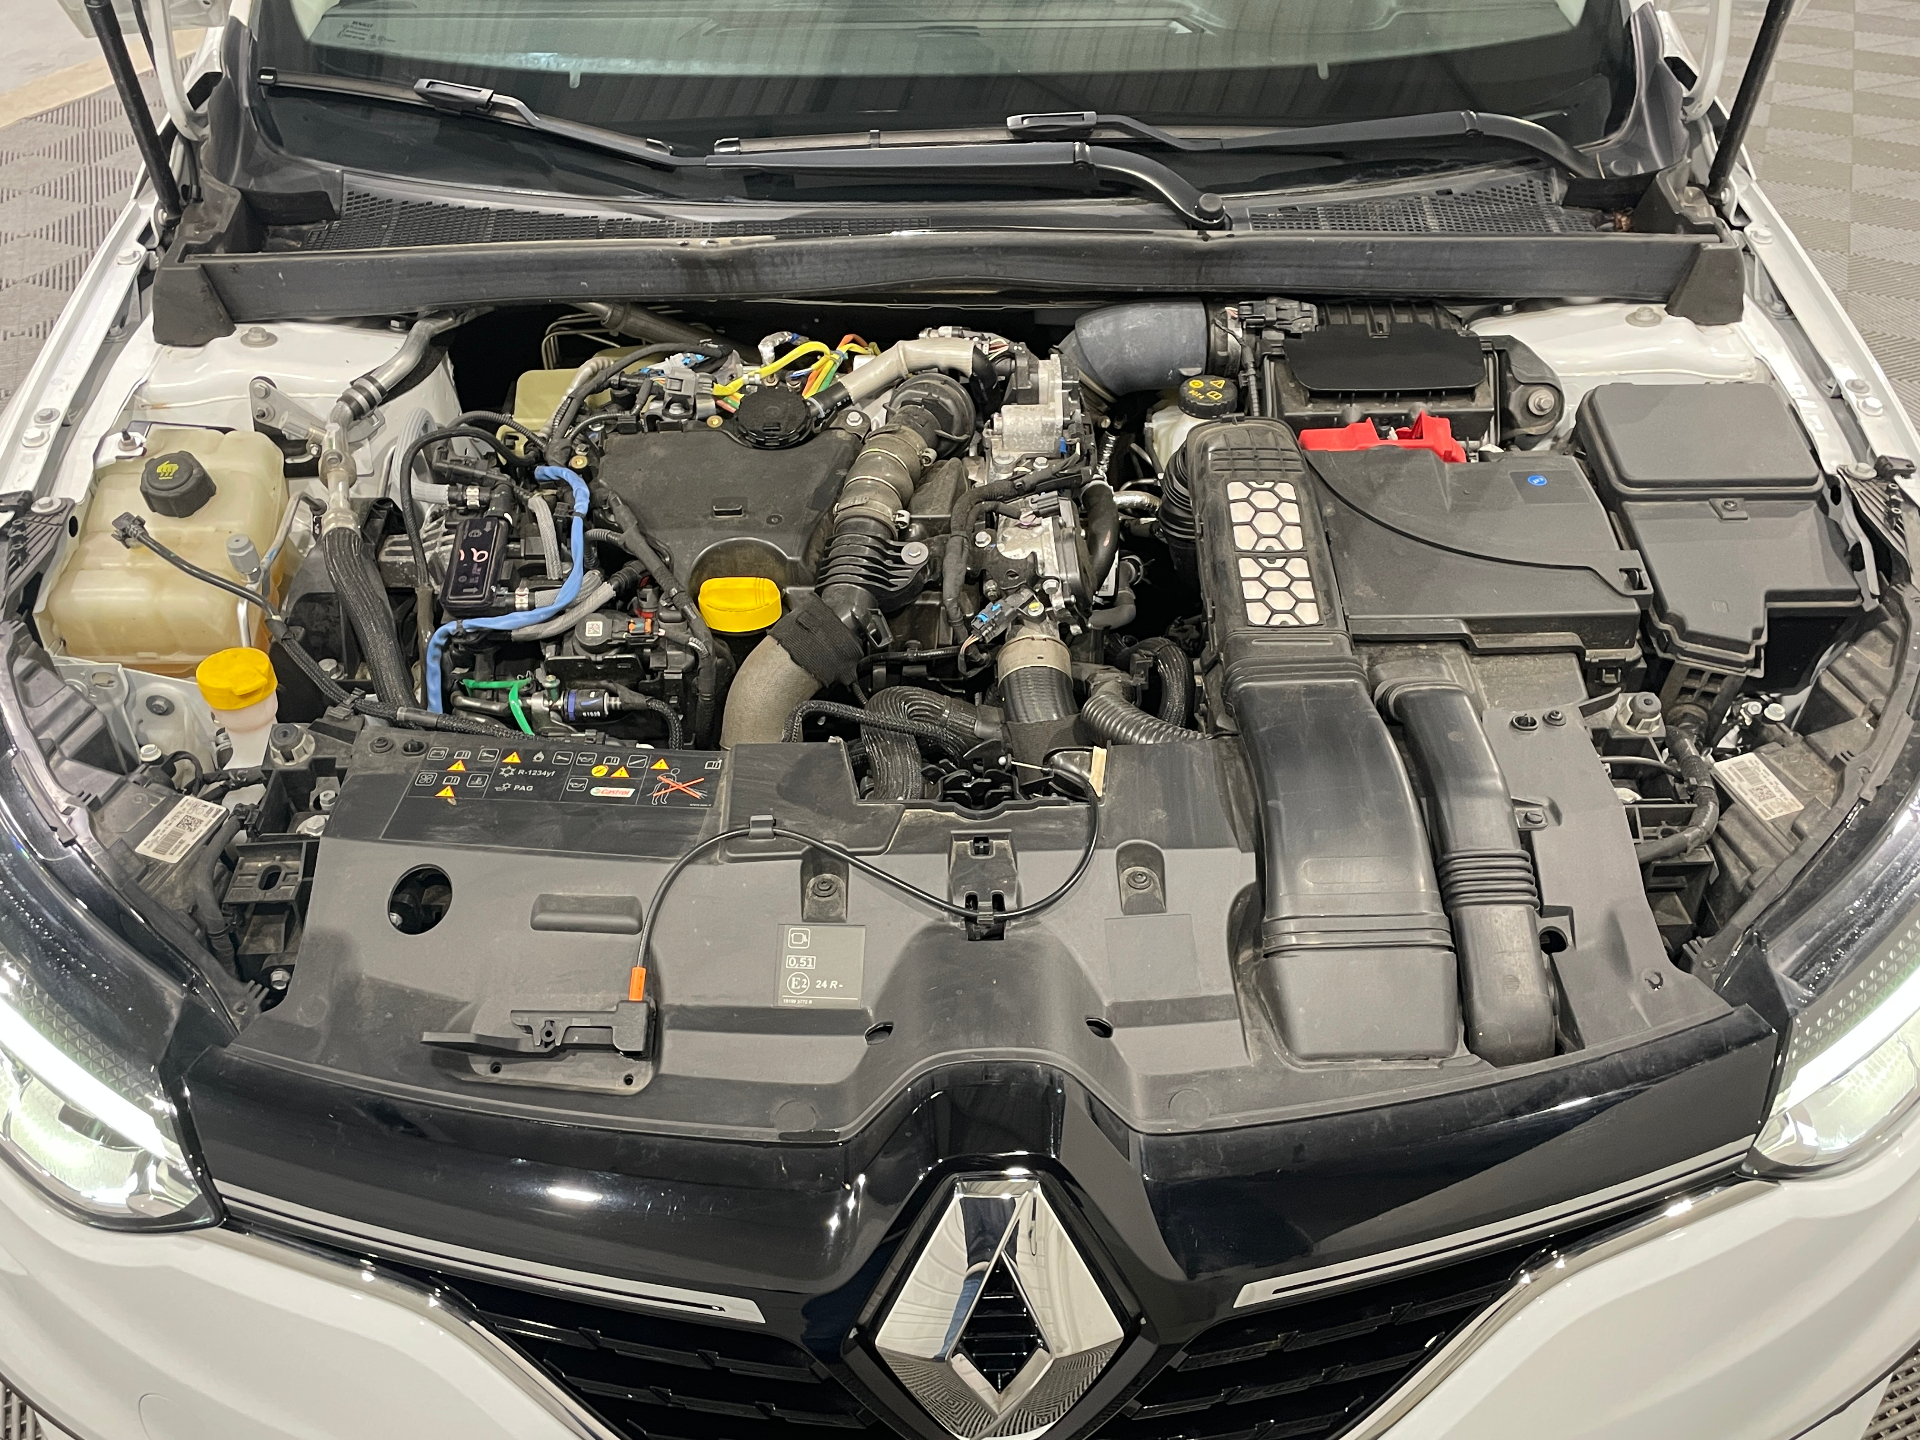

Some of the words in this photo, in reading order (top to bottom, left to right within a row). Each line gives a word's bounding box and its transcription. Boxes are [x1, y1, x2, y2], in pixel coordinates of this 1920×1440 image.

[517, 768, 556, 778] R-1234yf
[513, 784, 534, 792] PAG
[600, 788, 631, 796] Castrol
[815, 980, 828, 989] 24
